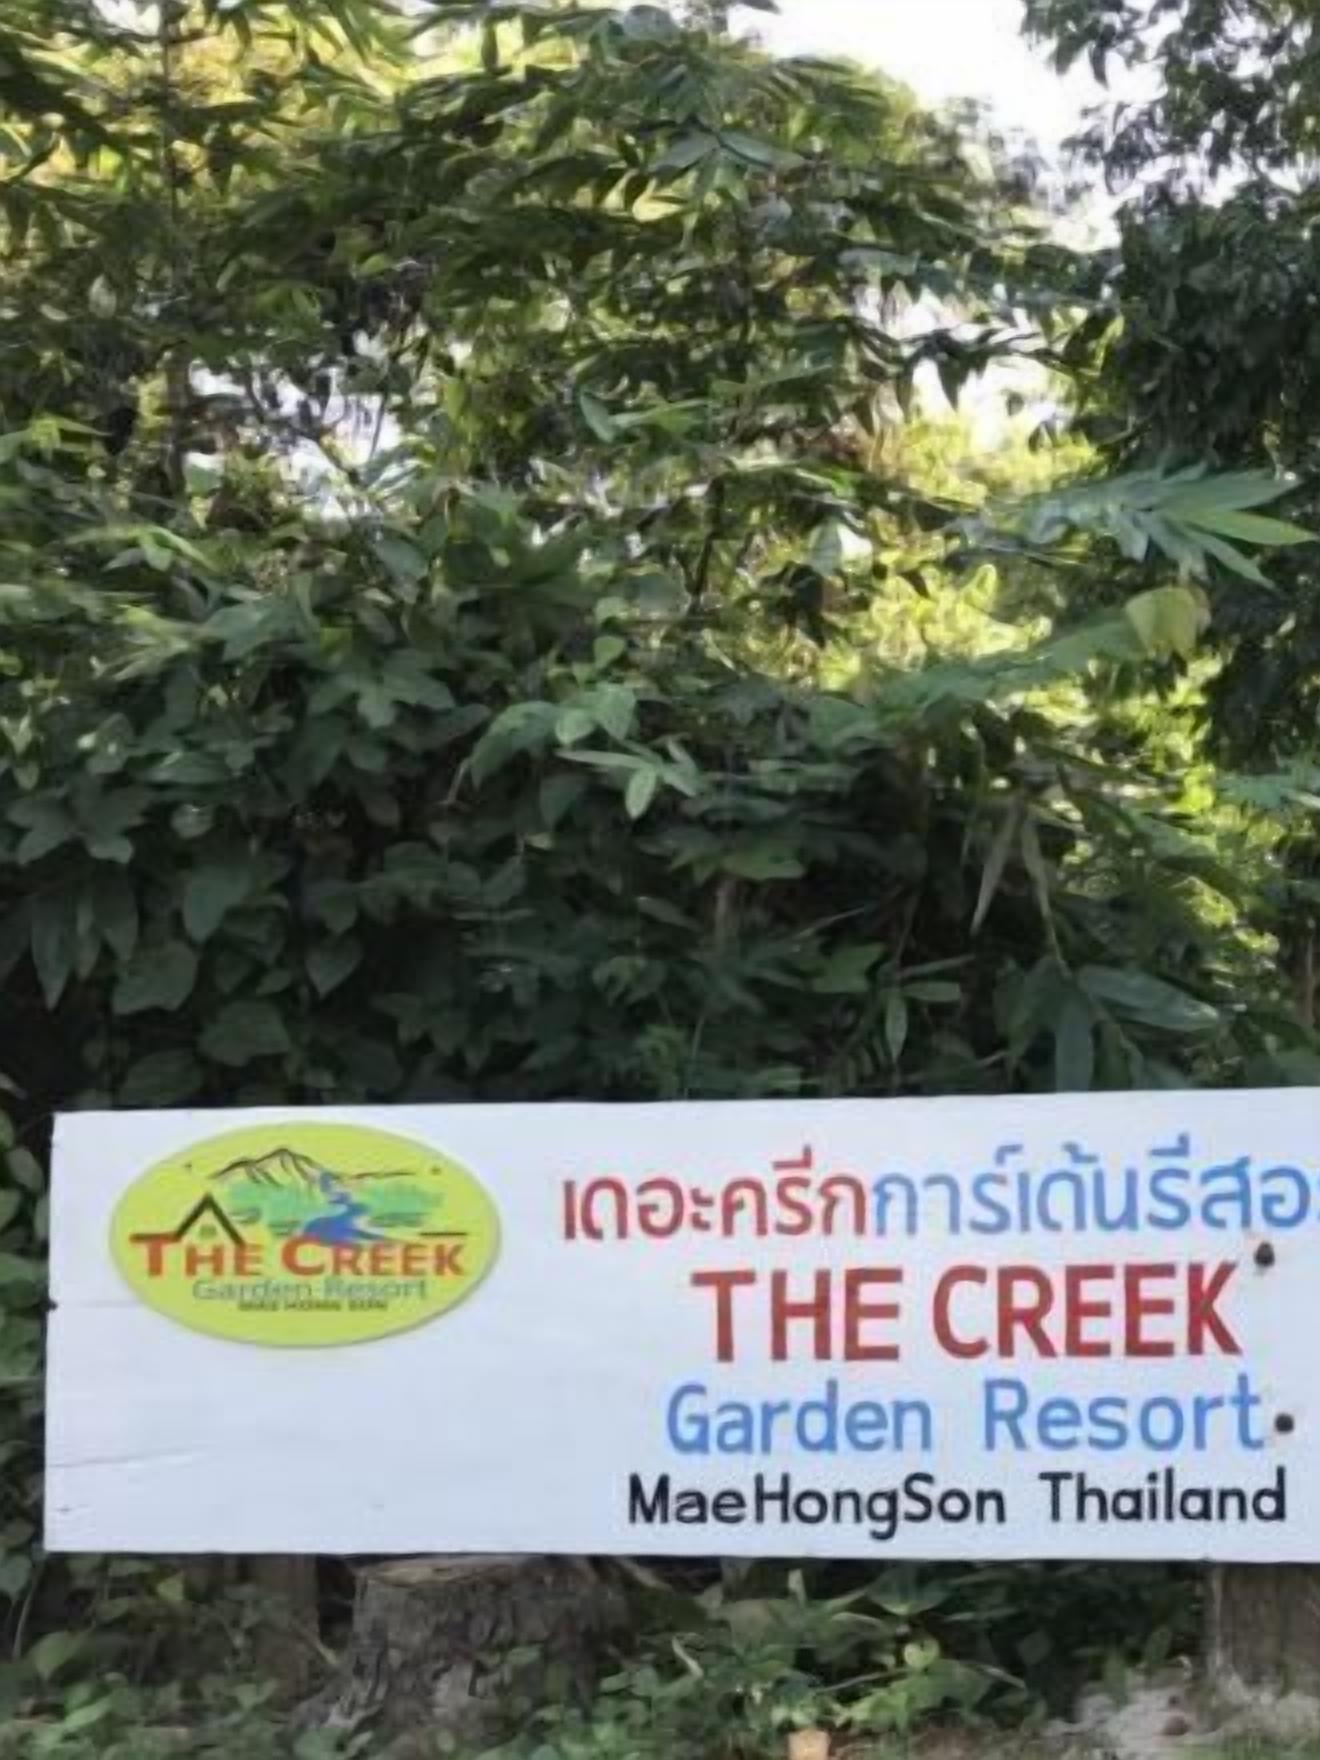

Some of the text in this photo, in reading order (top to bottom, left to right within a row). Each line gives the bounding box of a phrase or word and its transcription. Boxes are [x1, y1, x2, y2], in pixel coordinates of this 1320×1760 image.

[129, 1233, 466, 1277] THE CREEK
[690, 1262, 1243, 1362] THE CREEK
[667, 1374, 1265, 1454] Garden Resort
[628, 1466, 1287, 1540] MaeHongSon Thailand
